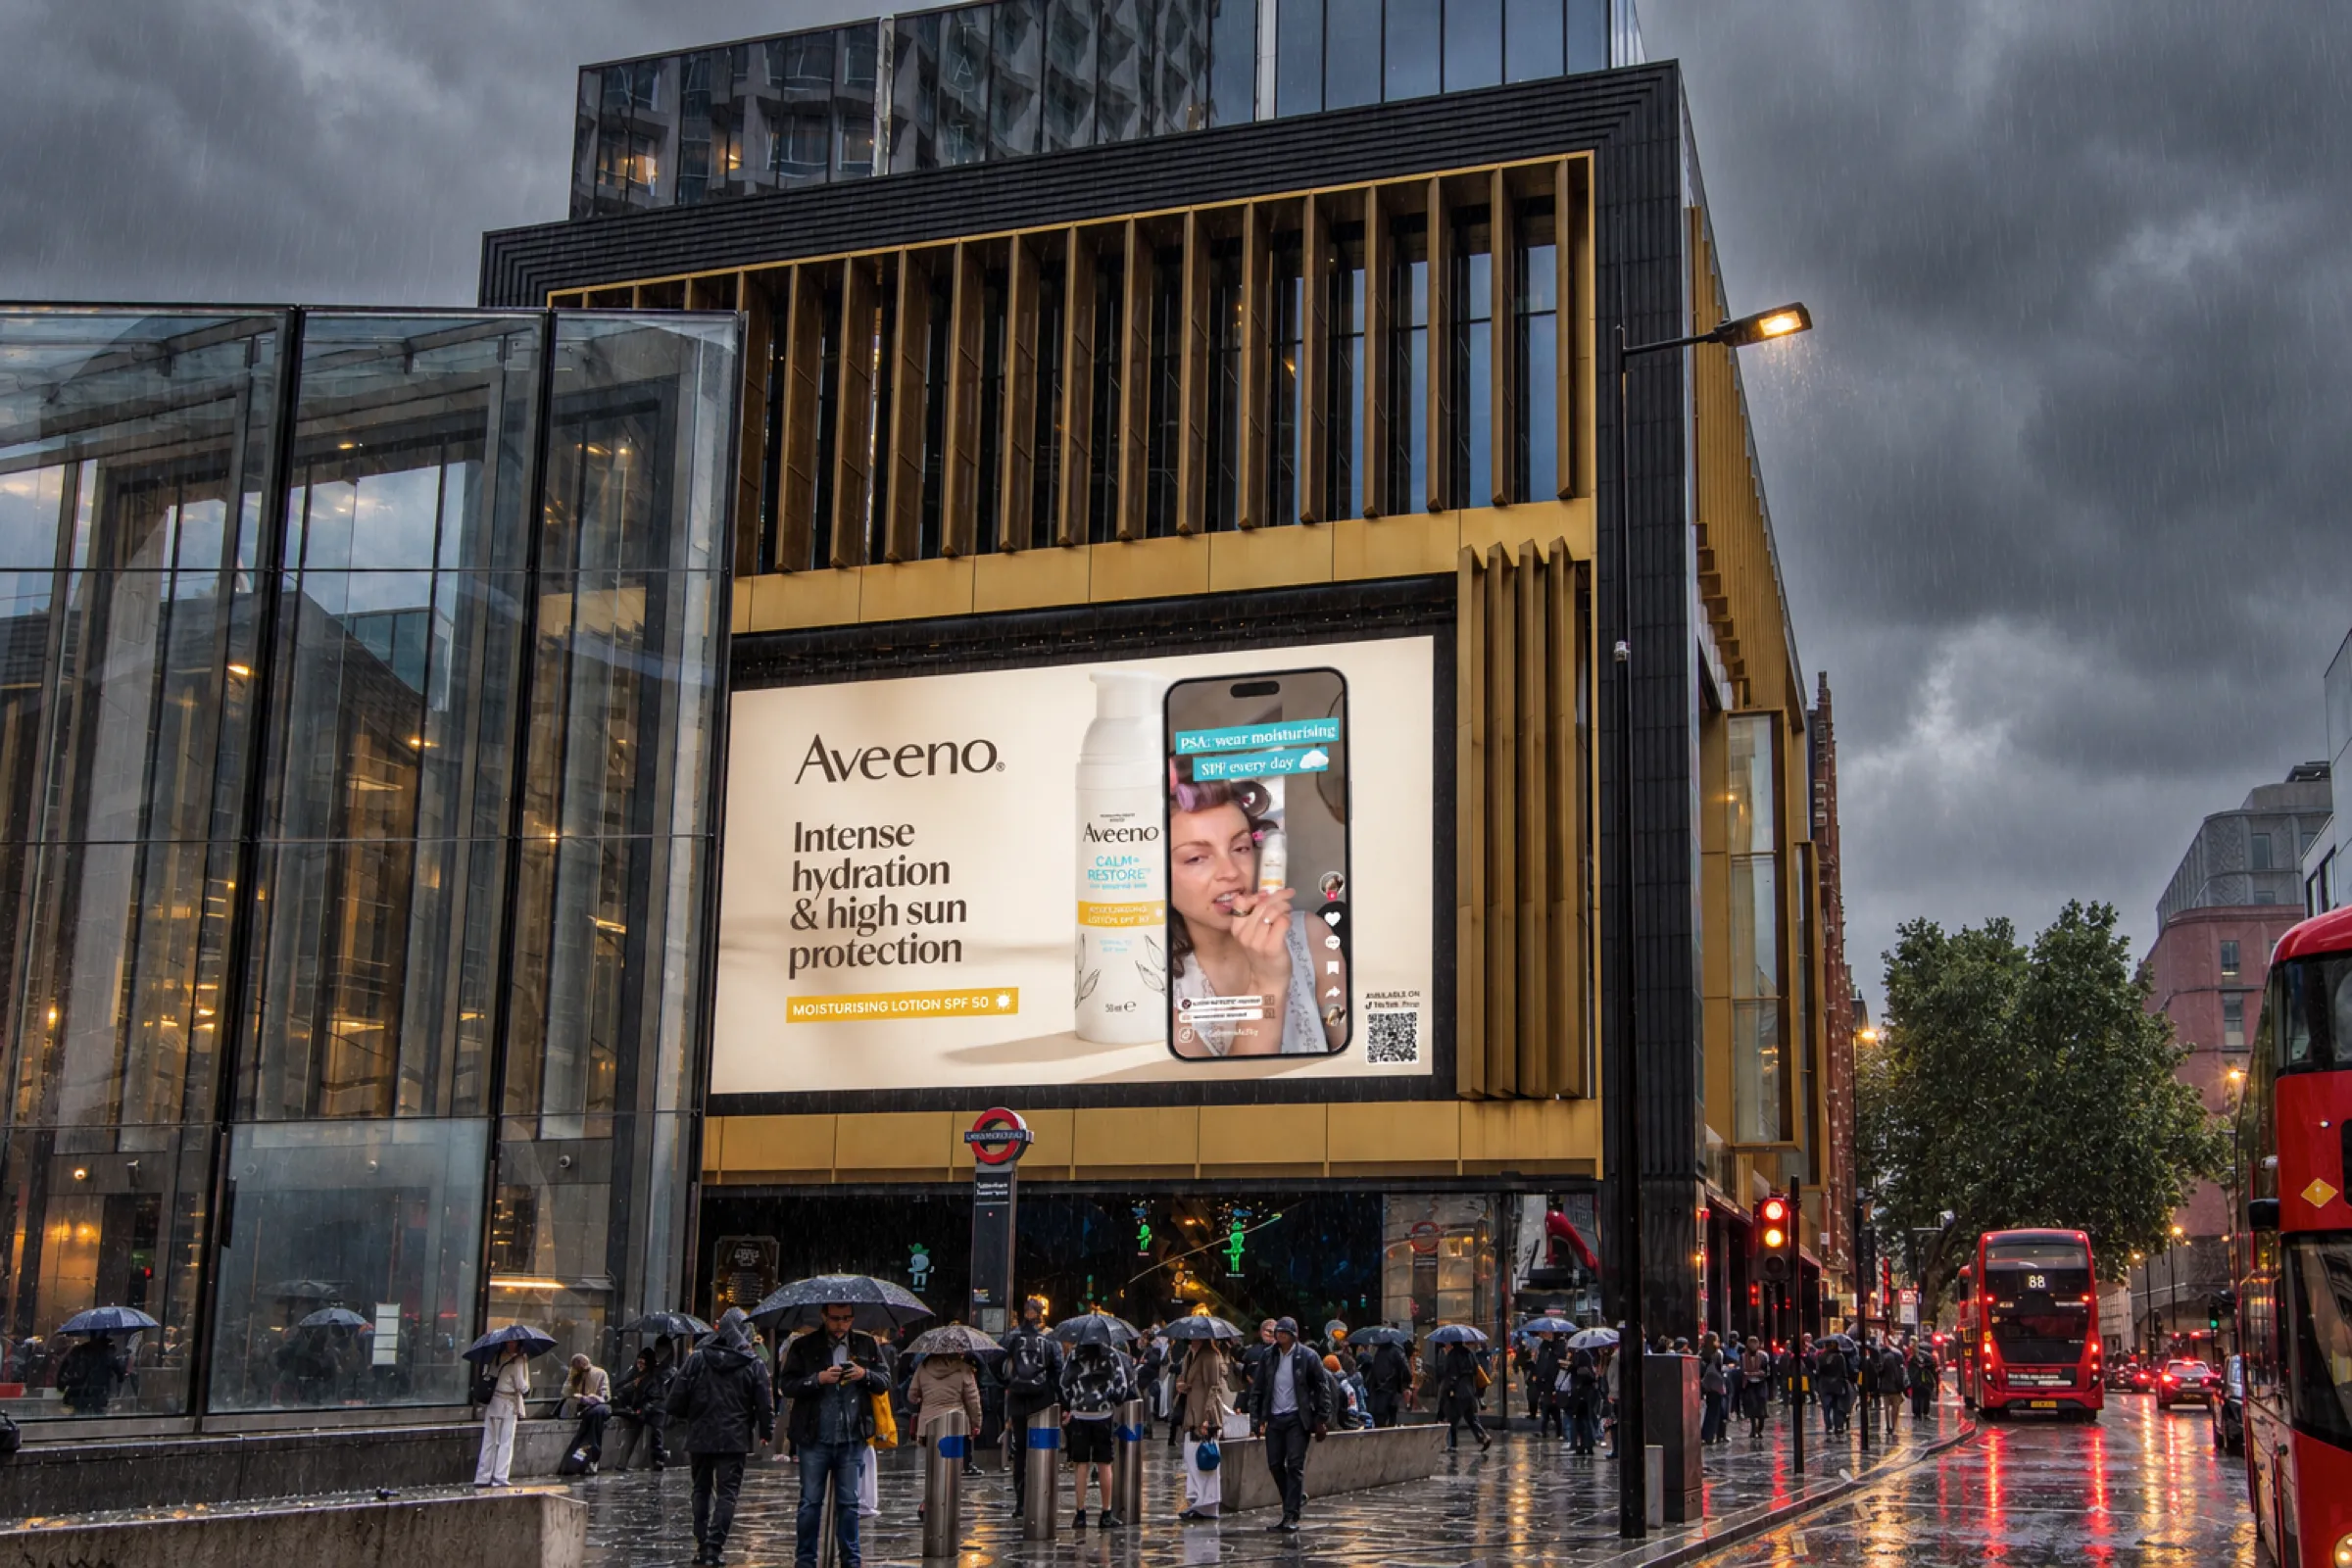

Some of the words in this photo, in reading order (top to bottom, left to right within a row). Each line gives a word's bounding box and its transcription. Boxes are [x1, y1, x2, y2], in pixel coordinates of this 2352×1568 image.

[1215, 735, 1248, 747] wear
[1251, 724, 1336, 744] moisturising
[1201, 761, 1225, 776] SPF
[1229, 760, 1266, 774] every
[1270, 757, 1296, 771] day
[794, 821, 915, 853] Intense
[1083, 822, 1159, 843] Aveeno
[792, 855, 951, 900] hydration
[790, 897, 817, 931] &
[827, 895, 899, 936] high
[906, 898, 967, 925] sun
[789, 932, 962, 979] protection
[793, 999, 888, 1016] MOISTURISING
[891, 998, 941, 1013] LOTION
[944, 997, 968, 1010] SPF
[971, 996, 989, 1008] 50
